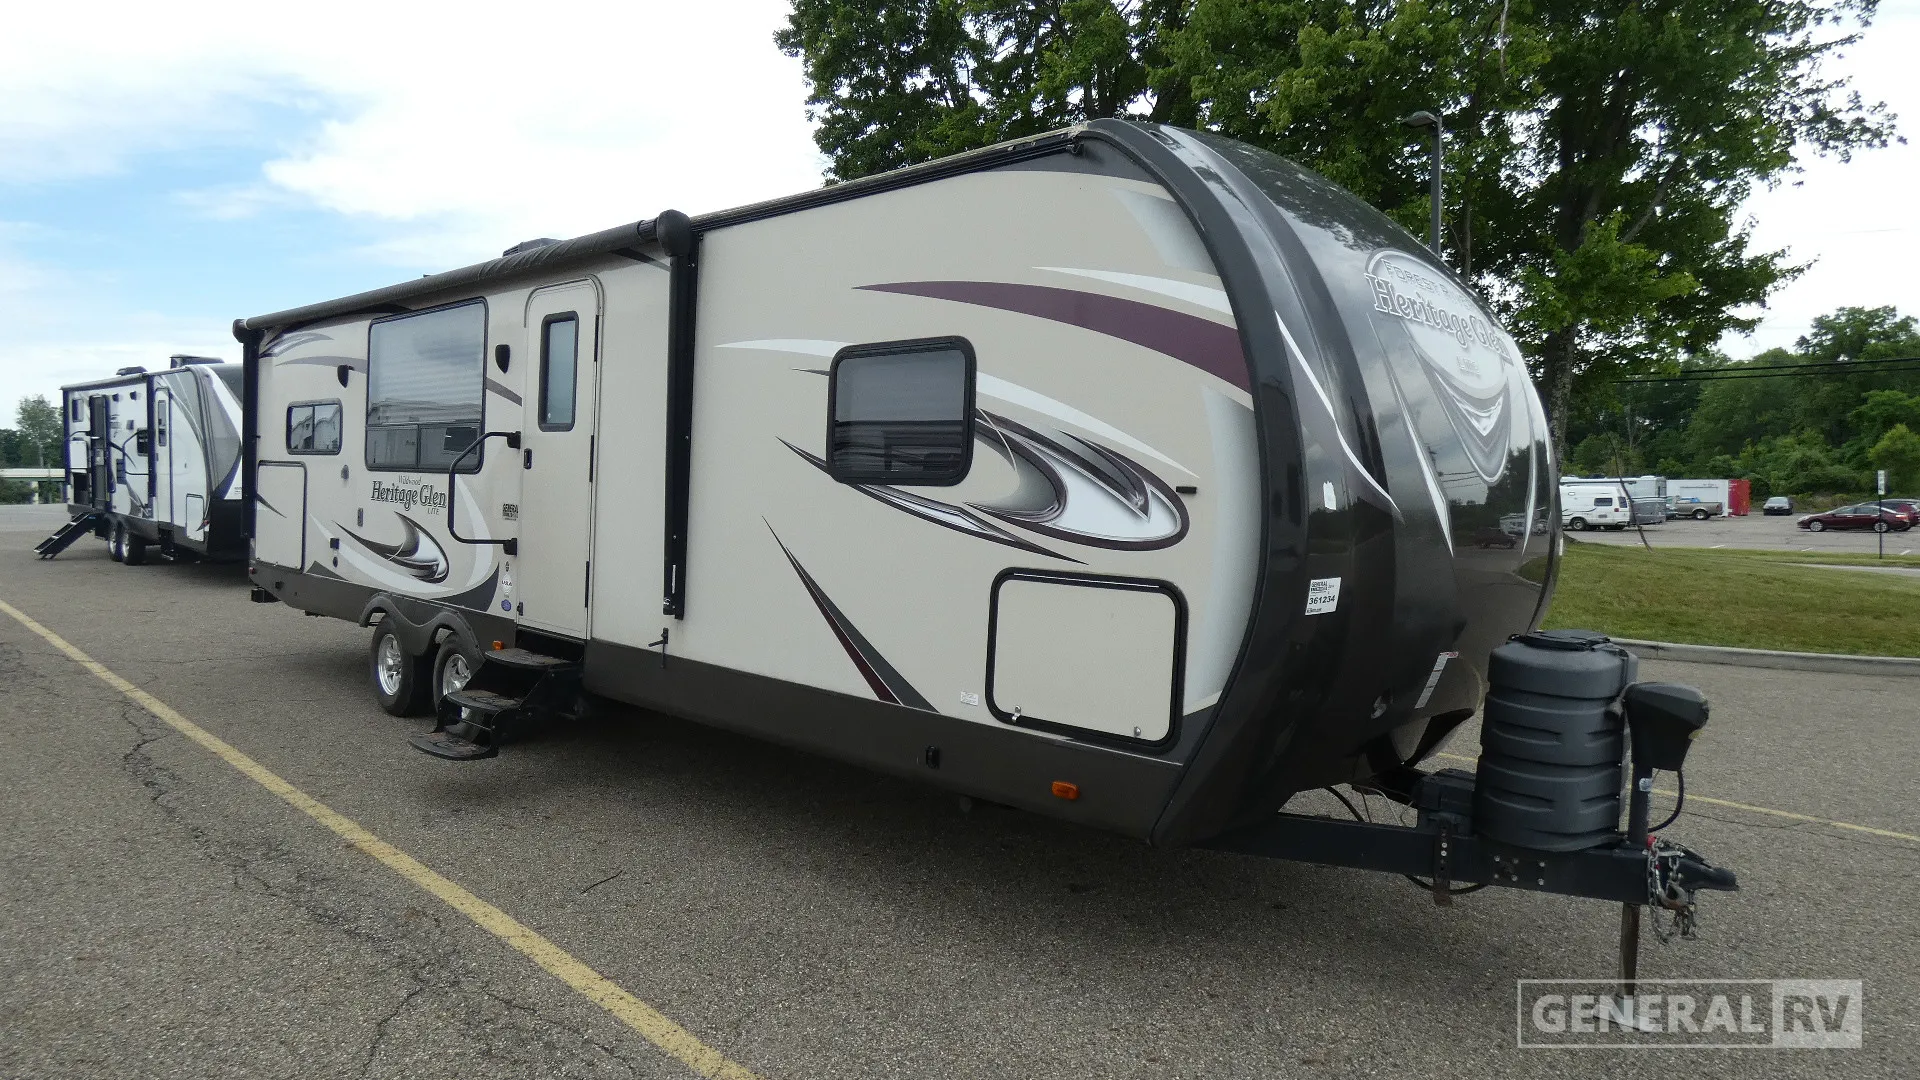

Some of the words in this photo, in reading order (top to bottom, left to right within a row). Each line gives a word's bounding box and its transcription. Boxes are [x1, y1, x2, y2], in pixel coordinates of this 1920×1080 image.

[1364, 273, 1473, 348] Heritage
[1469, 314, 1514, 366] Glen
[371, 481, 418, 511] Heritage
[420, 484, 447, 509] Glen
[1309, 595, 1335, 605] 361234
